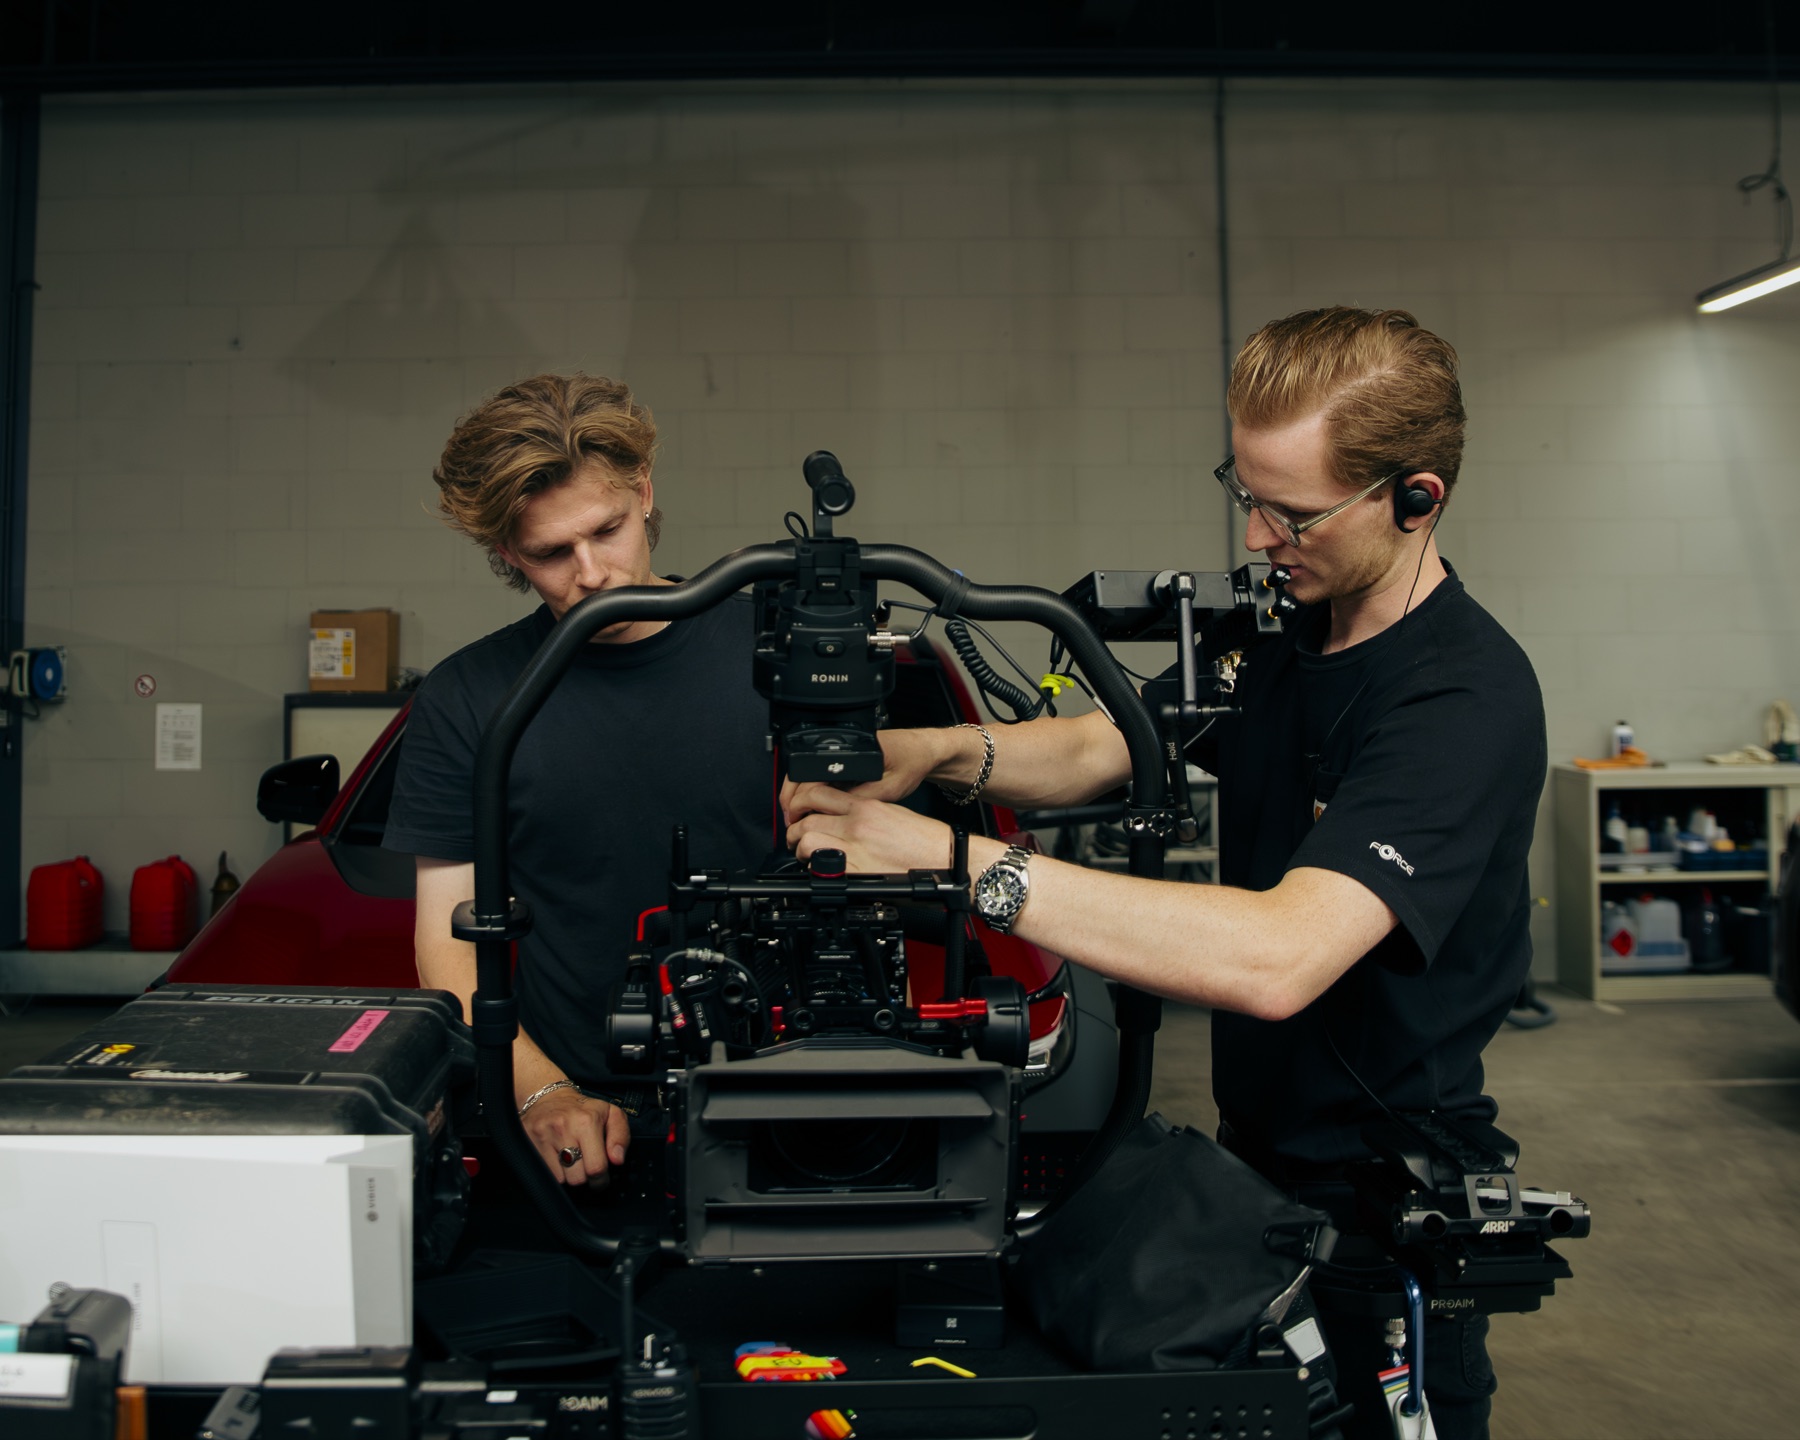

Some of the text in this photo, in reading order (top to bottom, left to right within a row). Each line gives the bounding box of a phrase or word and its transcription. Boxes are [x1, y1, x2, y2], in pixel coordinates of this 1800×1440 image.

[811, 674, 849, 682] RONIN
[1166, 742, 1178, 761] Hold
[1369, 841, 1415, 877] FORCE
[204, 996, 366, 1006] PELICAN
[1431, 1299, 1475, 1310] PROAIM
